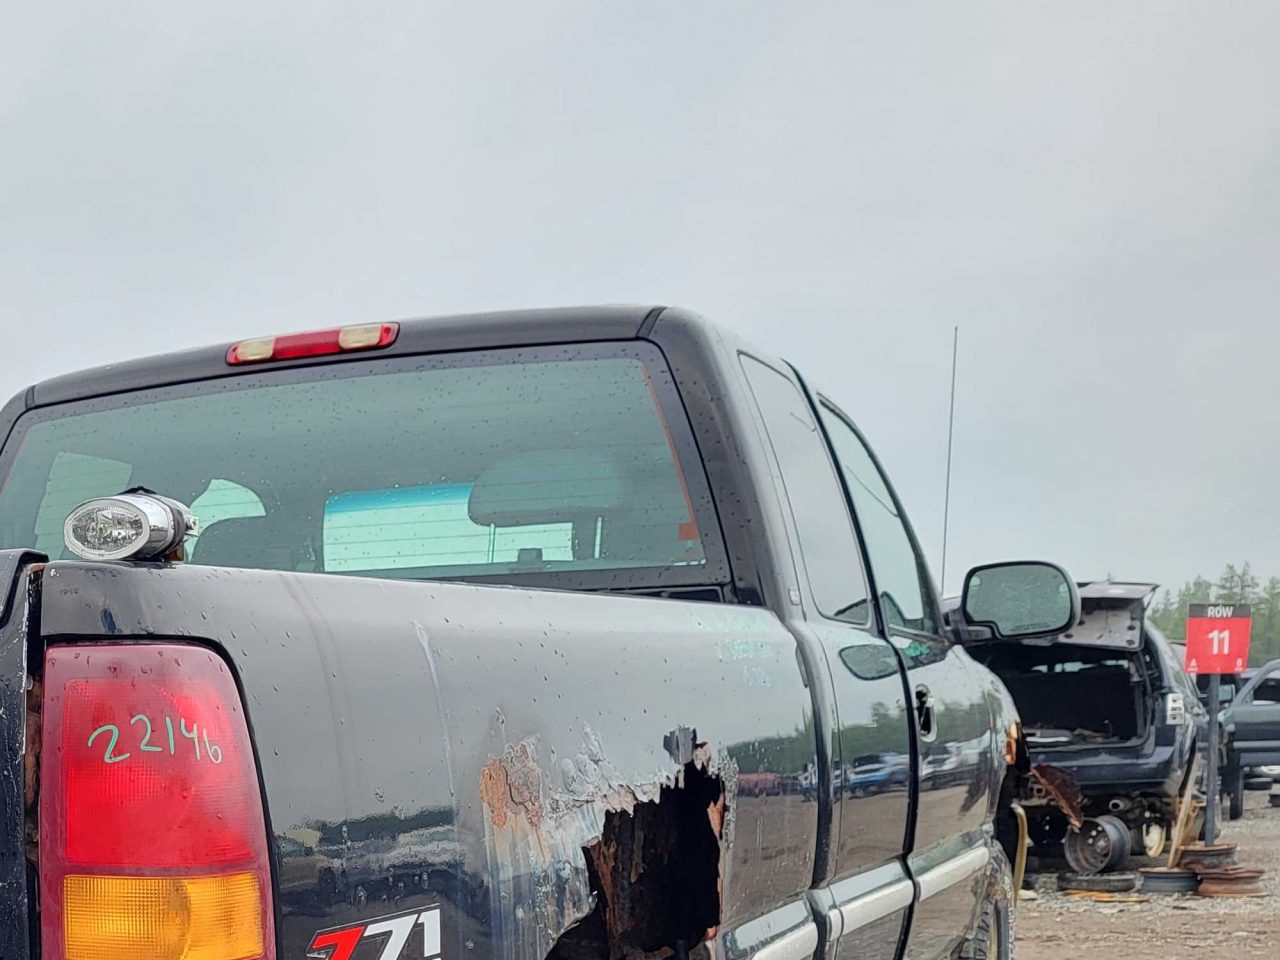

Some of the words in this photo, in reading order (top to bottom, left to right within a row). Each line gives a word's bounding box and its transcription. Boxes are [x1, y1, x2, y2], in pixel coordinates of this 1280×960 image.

[1207, 605, 1234, 619] ROW
[1207, 629, 1230, 656] 11
[86, 713, 222, 764] 22146
